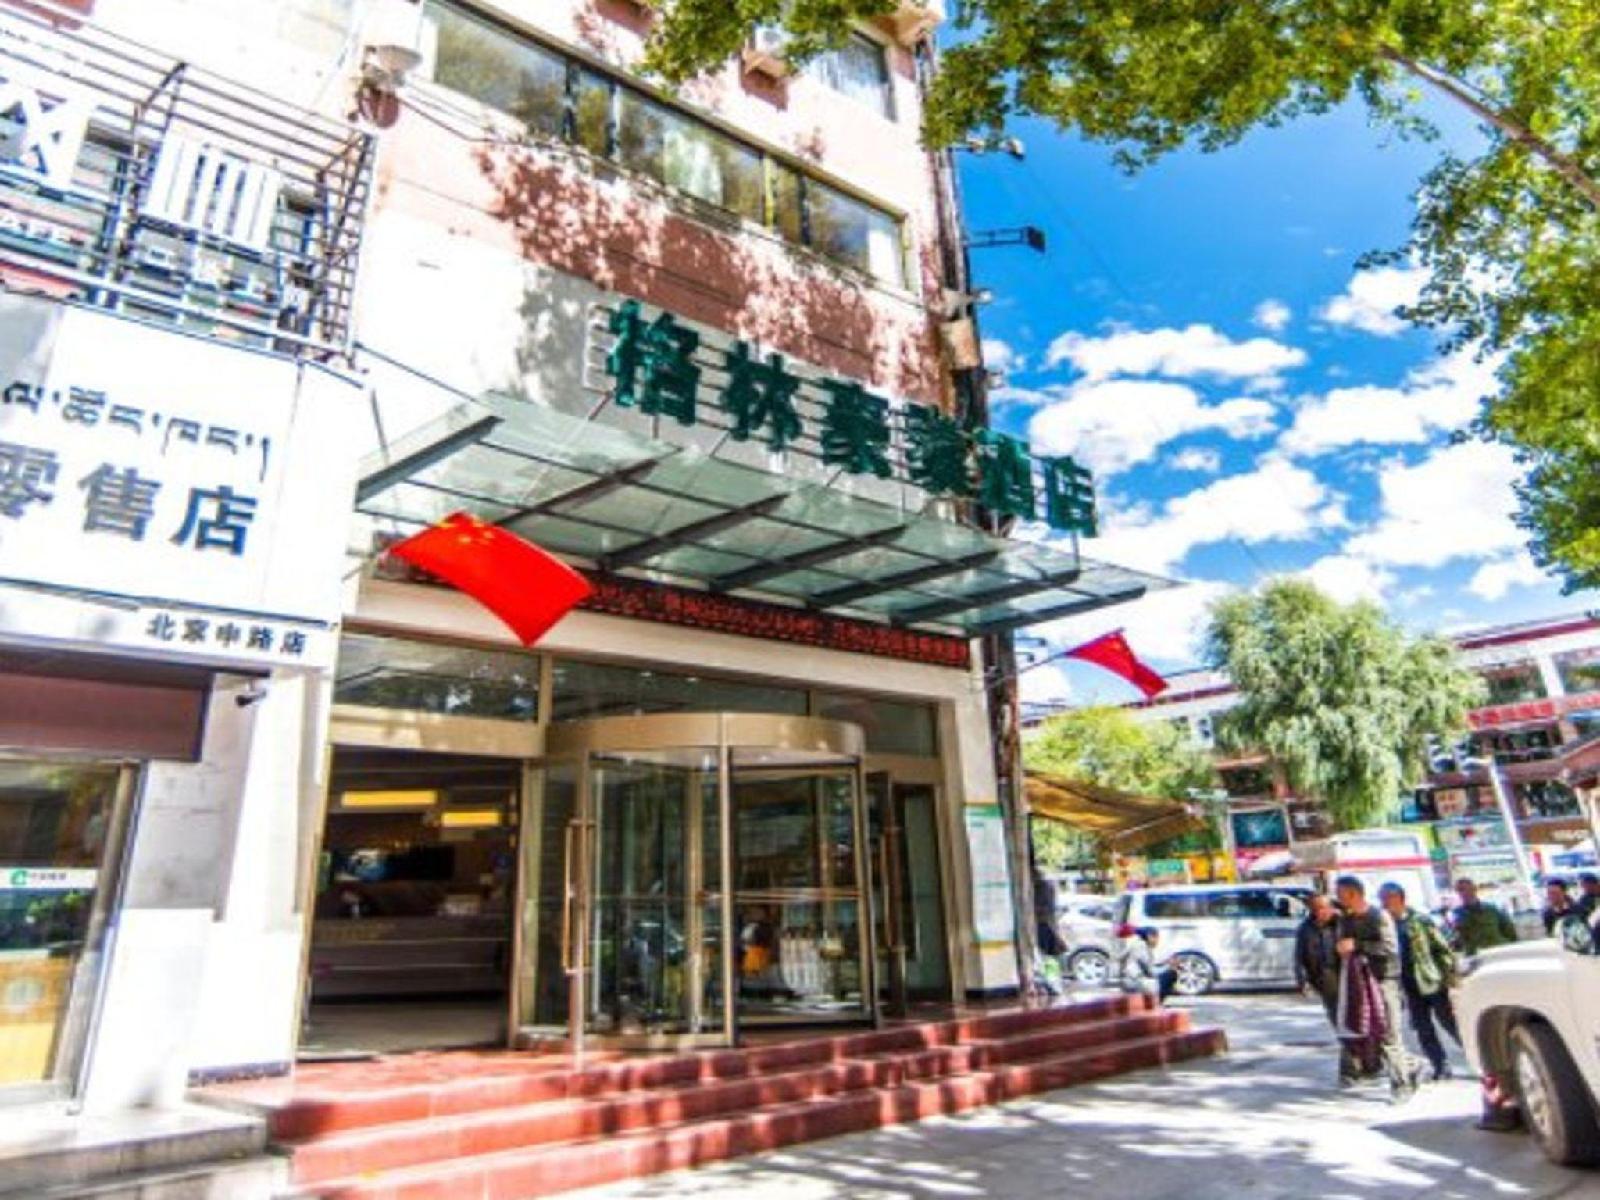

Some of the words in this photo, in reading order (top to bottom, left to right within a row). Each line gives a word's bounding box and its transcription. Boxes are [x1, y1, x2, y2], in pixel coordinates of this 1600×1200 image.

[0, 442, 257, 556] 零售店
[146, 613, 307, 657] 北京中路店
